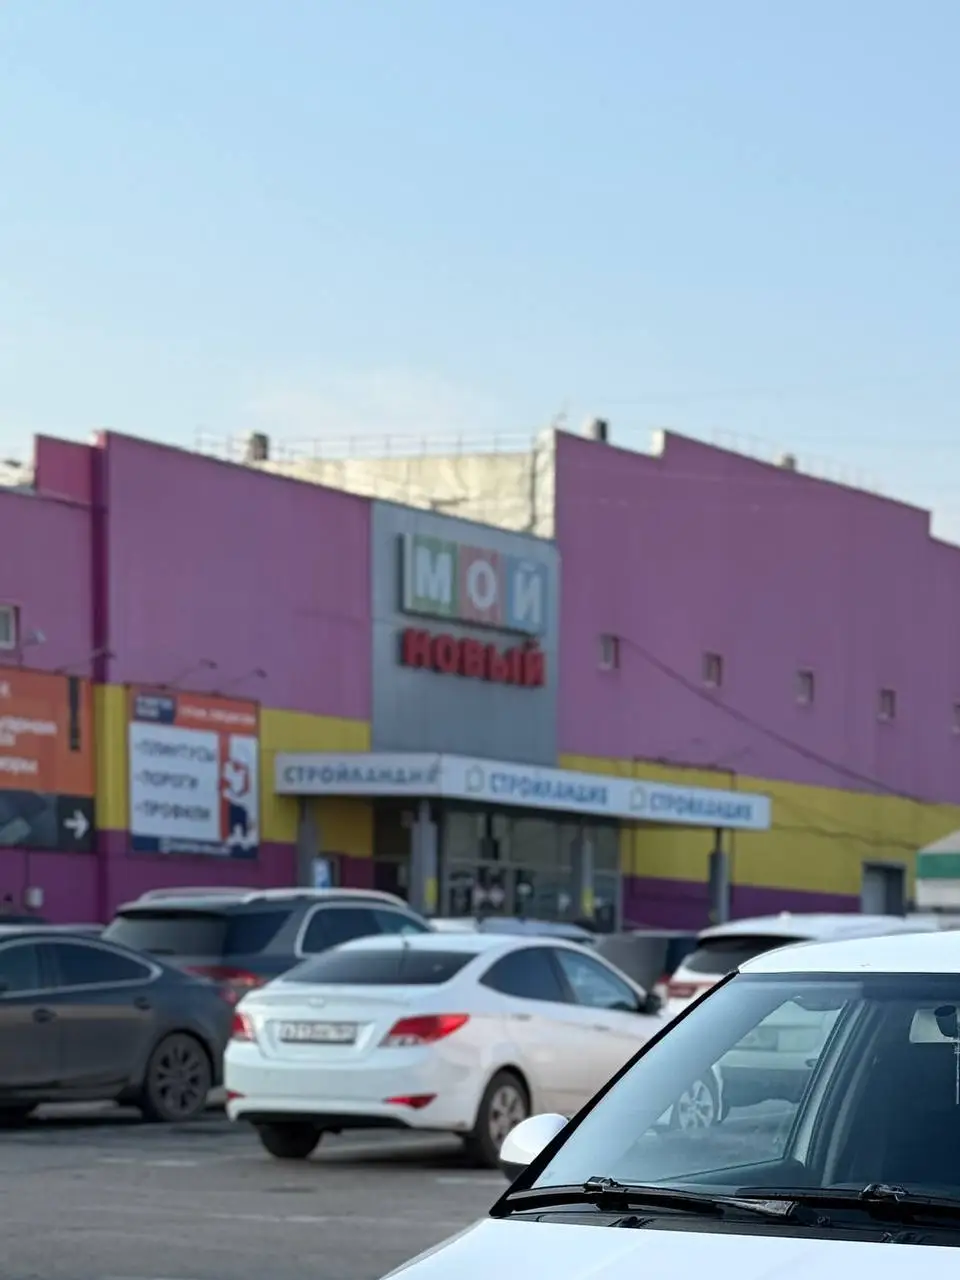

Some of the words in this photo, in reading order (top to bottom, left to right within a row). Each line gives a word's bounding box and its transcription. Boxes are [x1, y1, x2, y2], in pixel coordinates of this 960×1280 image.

[416, 546, 542, 624] МОЙ
[404, 628, 545, 687] НОВЫЙ
[489, 771, 610, 805] СТРОЙЛАНДИЯ
